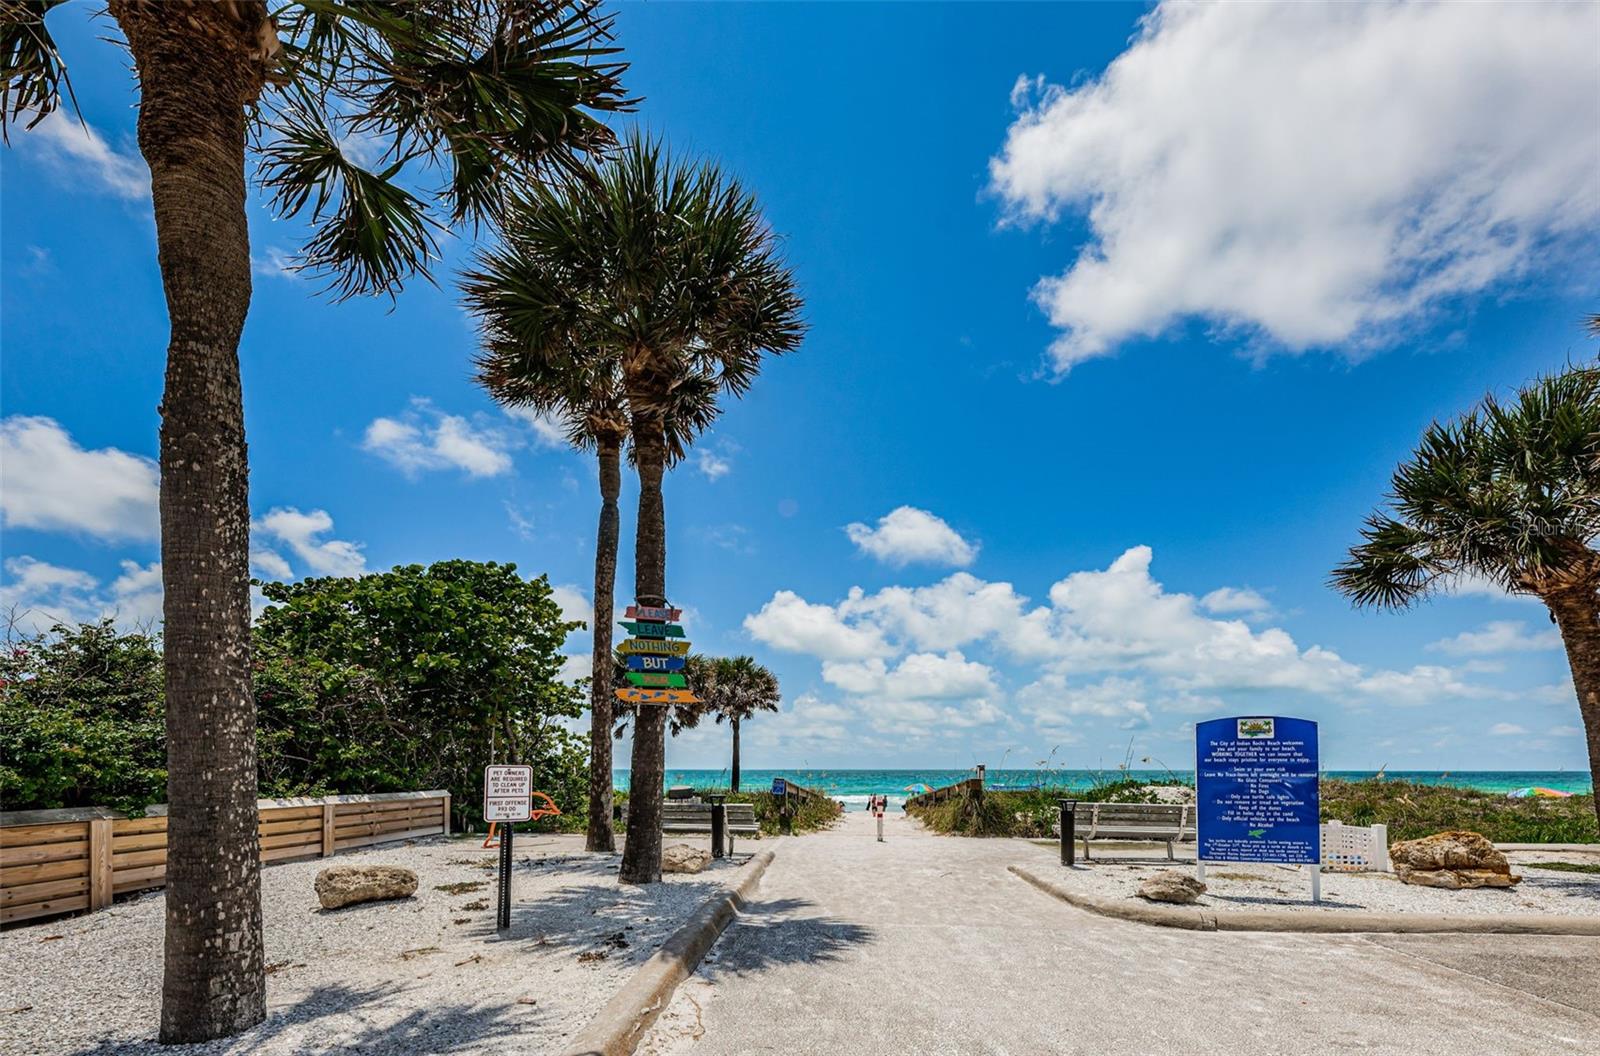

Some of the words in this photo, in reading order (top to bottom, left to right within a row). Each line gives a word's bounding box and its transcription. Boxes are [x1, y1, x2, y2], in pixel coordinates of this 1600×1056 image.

[638, 624, 670, 635] LEAVE
[630, 640, 680, 651] NOTHING
[642, 657, 668, 669] BUT
